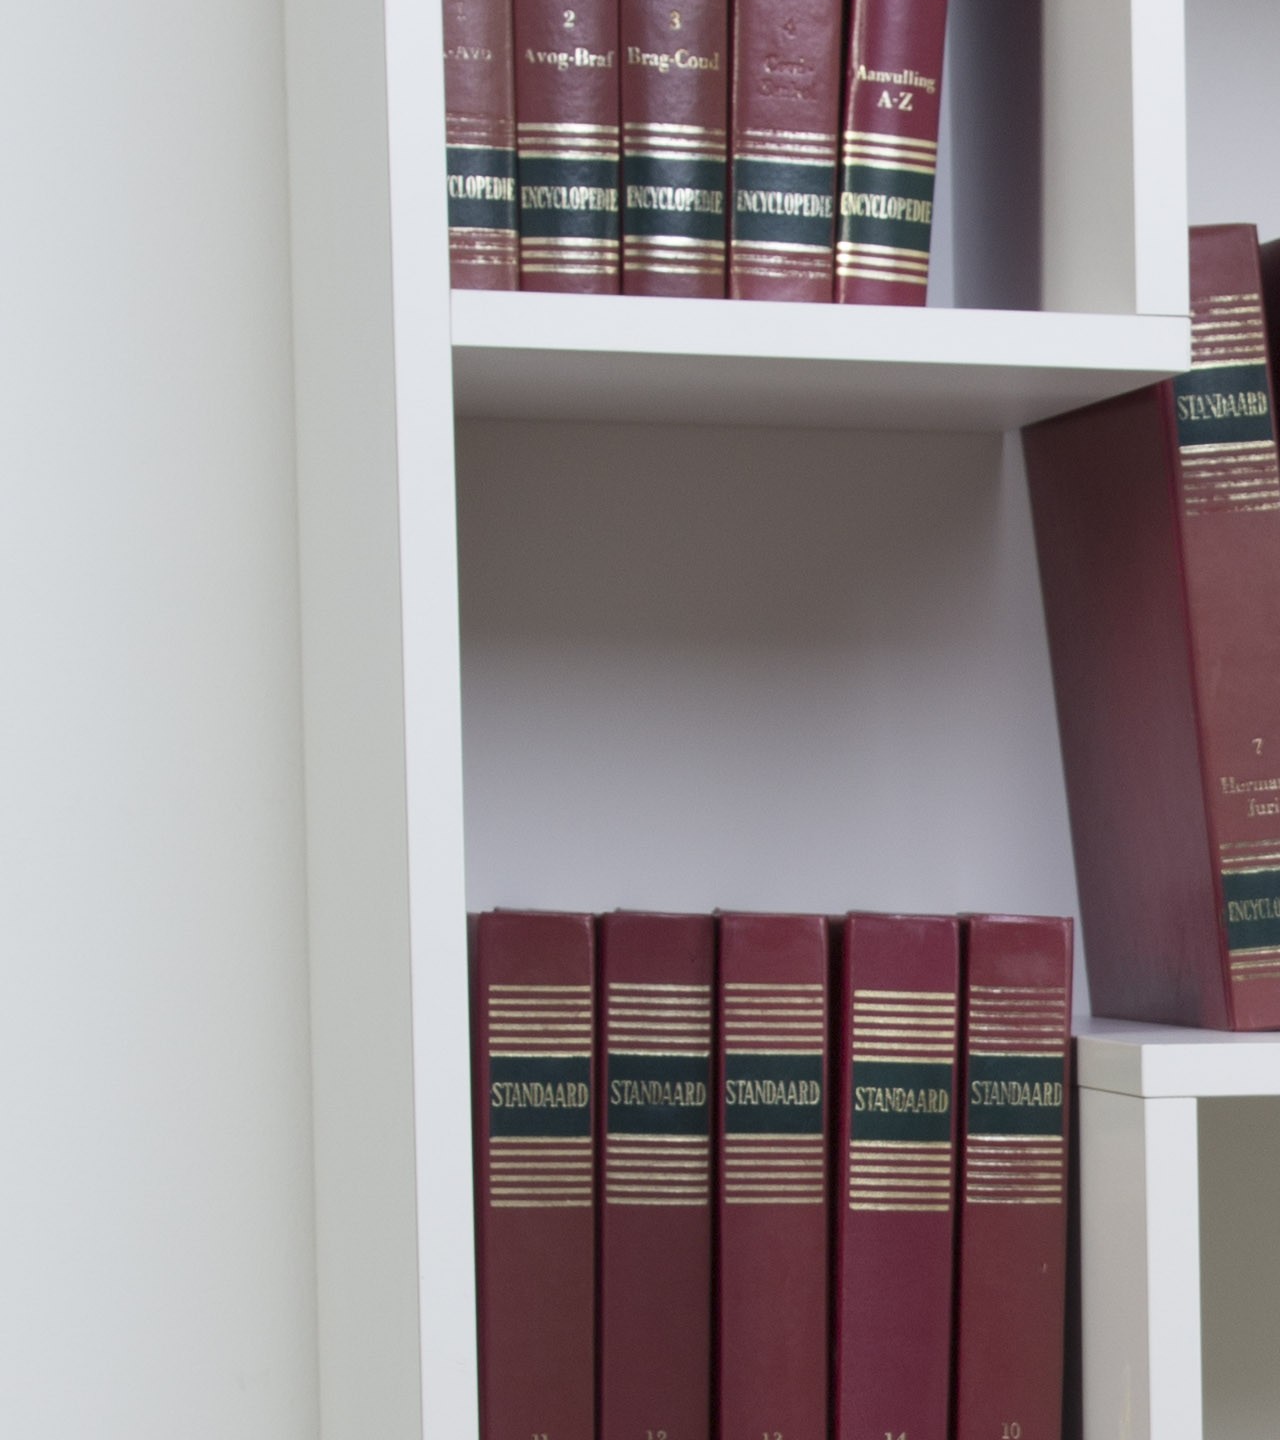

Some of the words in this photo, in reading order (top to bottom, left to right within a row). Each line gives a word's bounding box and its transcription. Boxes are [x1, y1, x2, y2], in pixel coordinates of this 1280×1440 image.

[562, 9, 575, 28] 2
[668, 10, 682, 31] 3
[857, 64, 936, 93] Aanvulling
[877, 91, 914, 112] A-Z
[521, 185, 619, 212] ENCYCLOPEDIE
[627, 185, 723, 215] ENCYCLOPEDIE
[737, 189, 833, 218] ENCYCLOPEDIE
[841, 191, 932, 224] ENCYCLOPEDIE
[1177, 391, 1269, 421] STANDAARD
[1252, 738, 1263, 755] 7
[491, 1081, 589, 1108] STANDAARD
[610, 1079, 707, 1107] STANDAARD
[725, 1079, 821, 1106] STANDAARD
[854, 1086, 949, 1113] STANDAARD
[970, 1080, 1063, 1107] STANDAARD
[1001, 1422, 1021, 1440] 10
